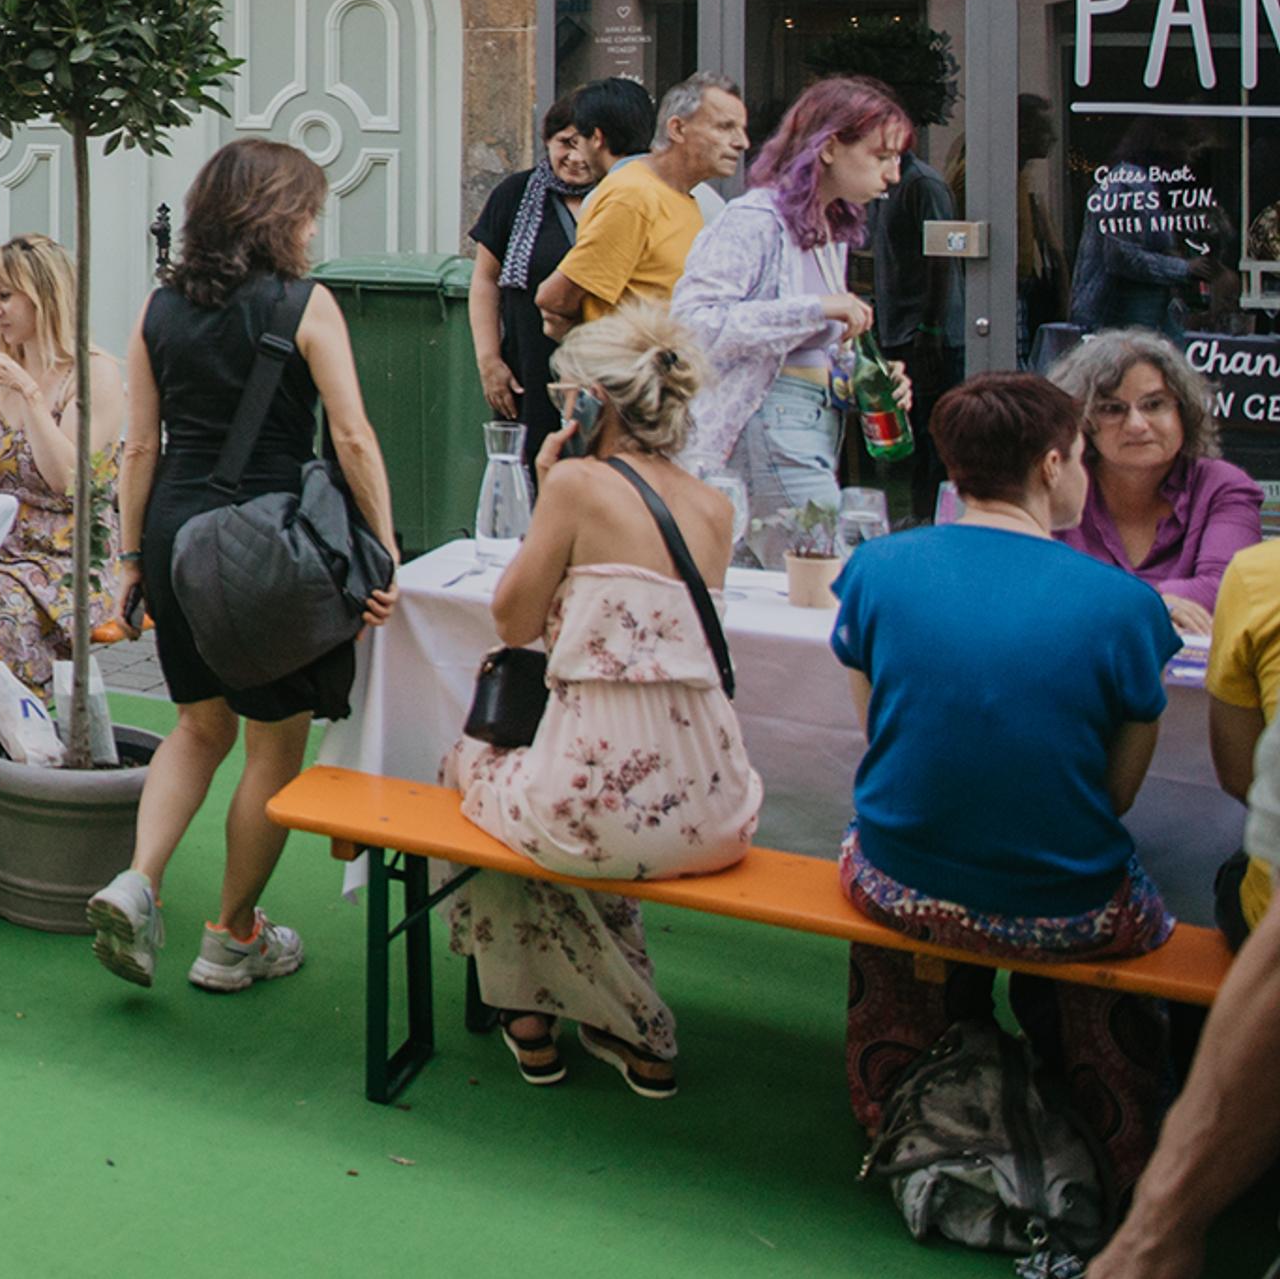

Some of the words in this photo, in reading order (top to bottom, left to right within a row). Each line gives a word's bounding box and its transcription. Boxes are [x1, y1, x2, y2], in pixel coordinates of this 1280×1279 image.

[1094, 163, 1147, 191] Gutes
[1148, 164, 1197, 183] Brot.
[1086, 191, 1160, 213] GUTES
[1168, 188, 1218, 209] TUN.
